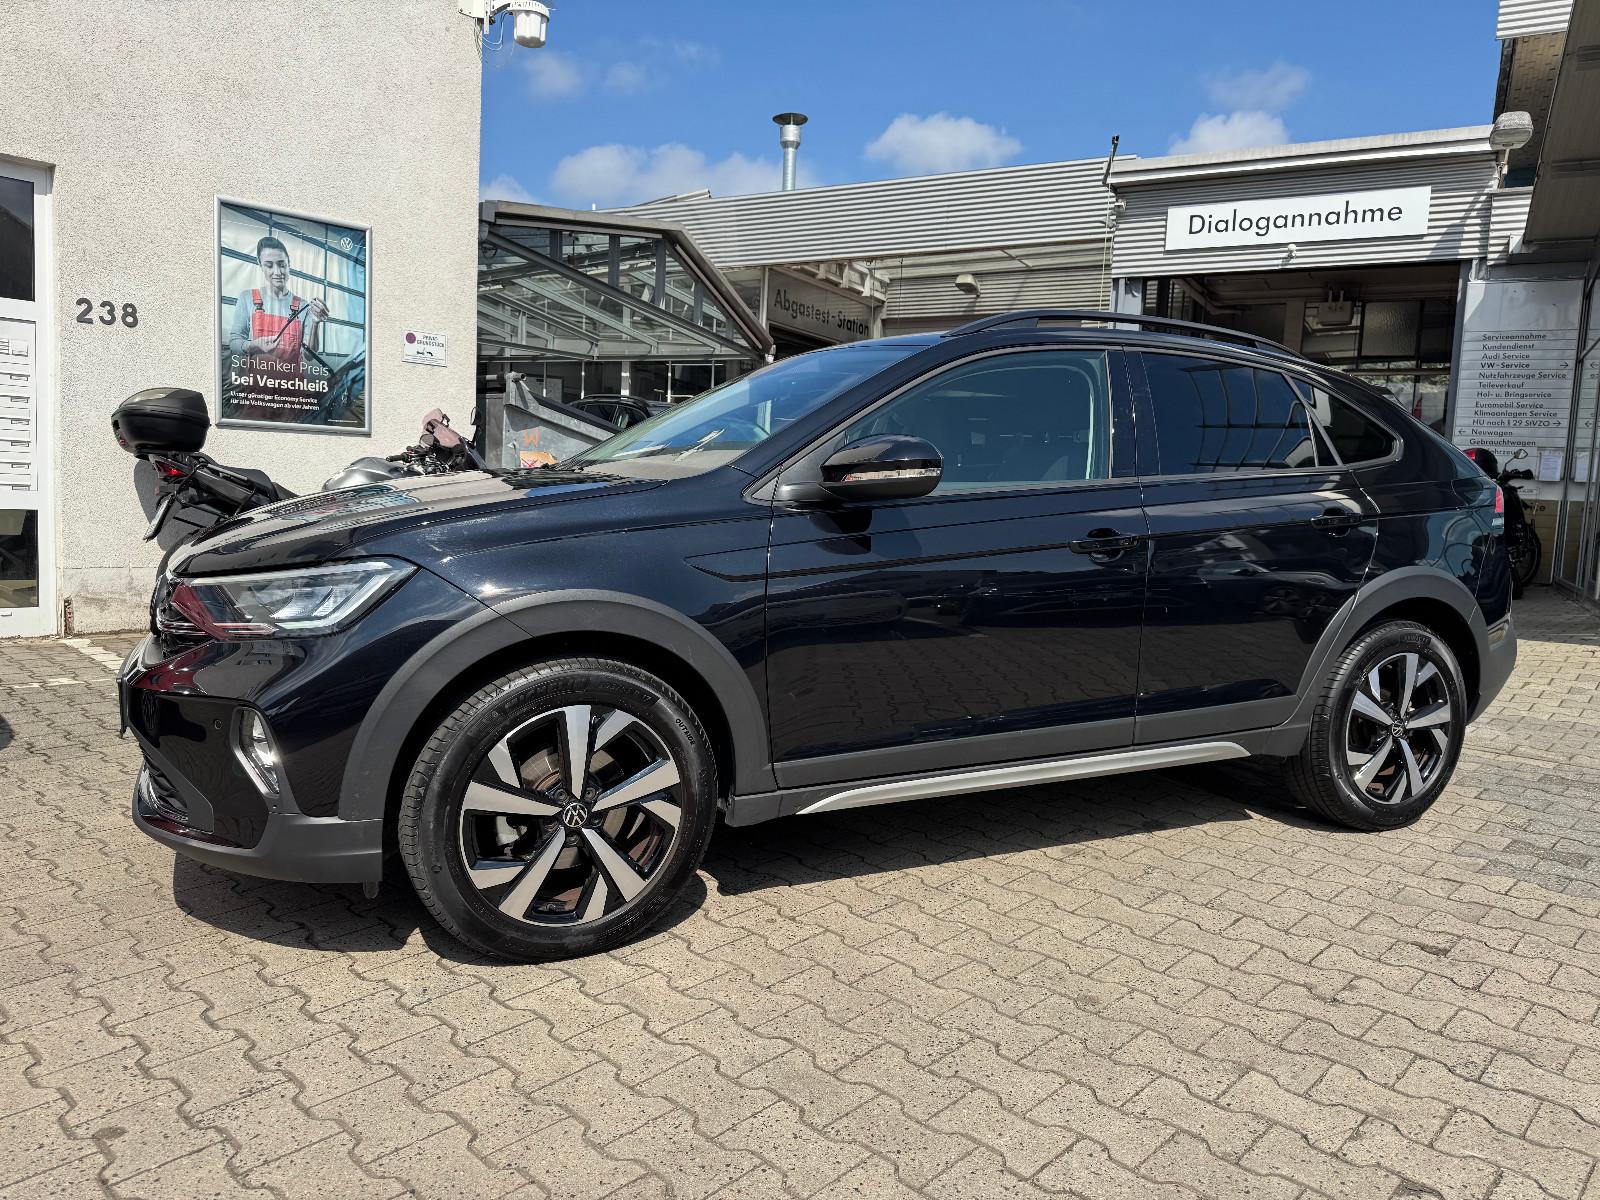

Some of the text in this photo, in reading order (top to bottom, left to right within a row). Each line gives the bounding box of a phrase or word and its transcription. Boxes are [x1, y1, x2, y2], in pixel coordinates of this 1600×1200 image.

[1188, 200, 1403, 237] Dialogannahme
[76, 298, 138, 328] 238
[774, 288, 870, 337] Abgastest-Station
[1482, 333, 1546, 341] Serviceannahme
[1502, 352, 1530, 360] Service
[231, 354, 329, 377] Schlanker Preis
[1479, 371, 1567, 380] Nutzfahrzeuge Service
[231, 372, 329, 393] bei Verschleiß
[1478, 381, 1525, 389] Teileverkauf
[230, 390, 248, 398] Unser
[274, 394, 299, 403] Economy
[1504, 391, 1552, 399] Bringservice
[250, 400, 283, 409] Volkswagen
[1475, 401, 1544, 409] Euromobil Service
[1474, 409, 1528, 418] Klimaanlagen
[1471, 428, 1513, 437] Neuwagen
[1469, 439, 1537, 447] Gebrauchtwagen
